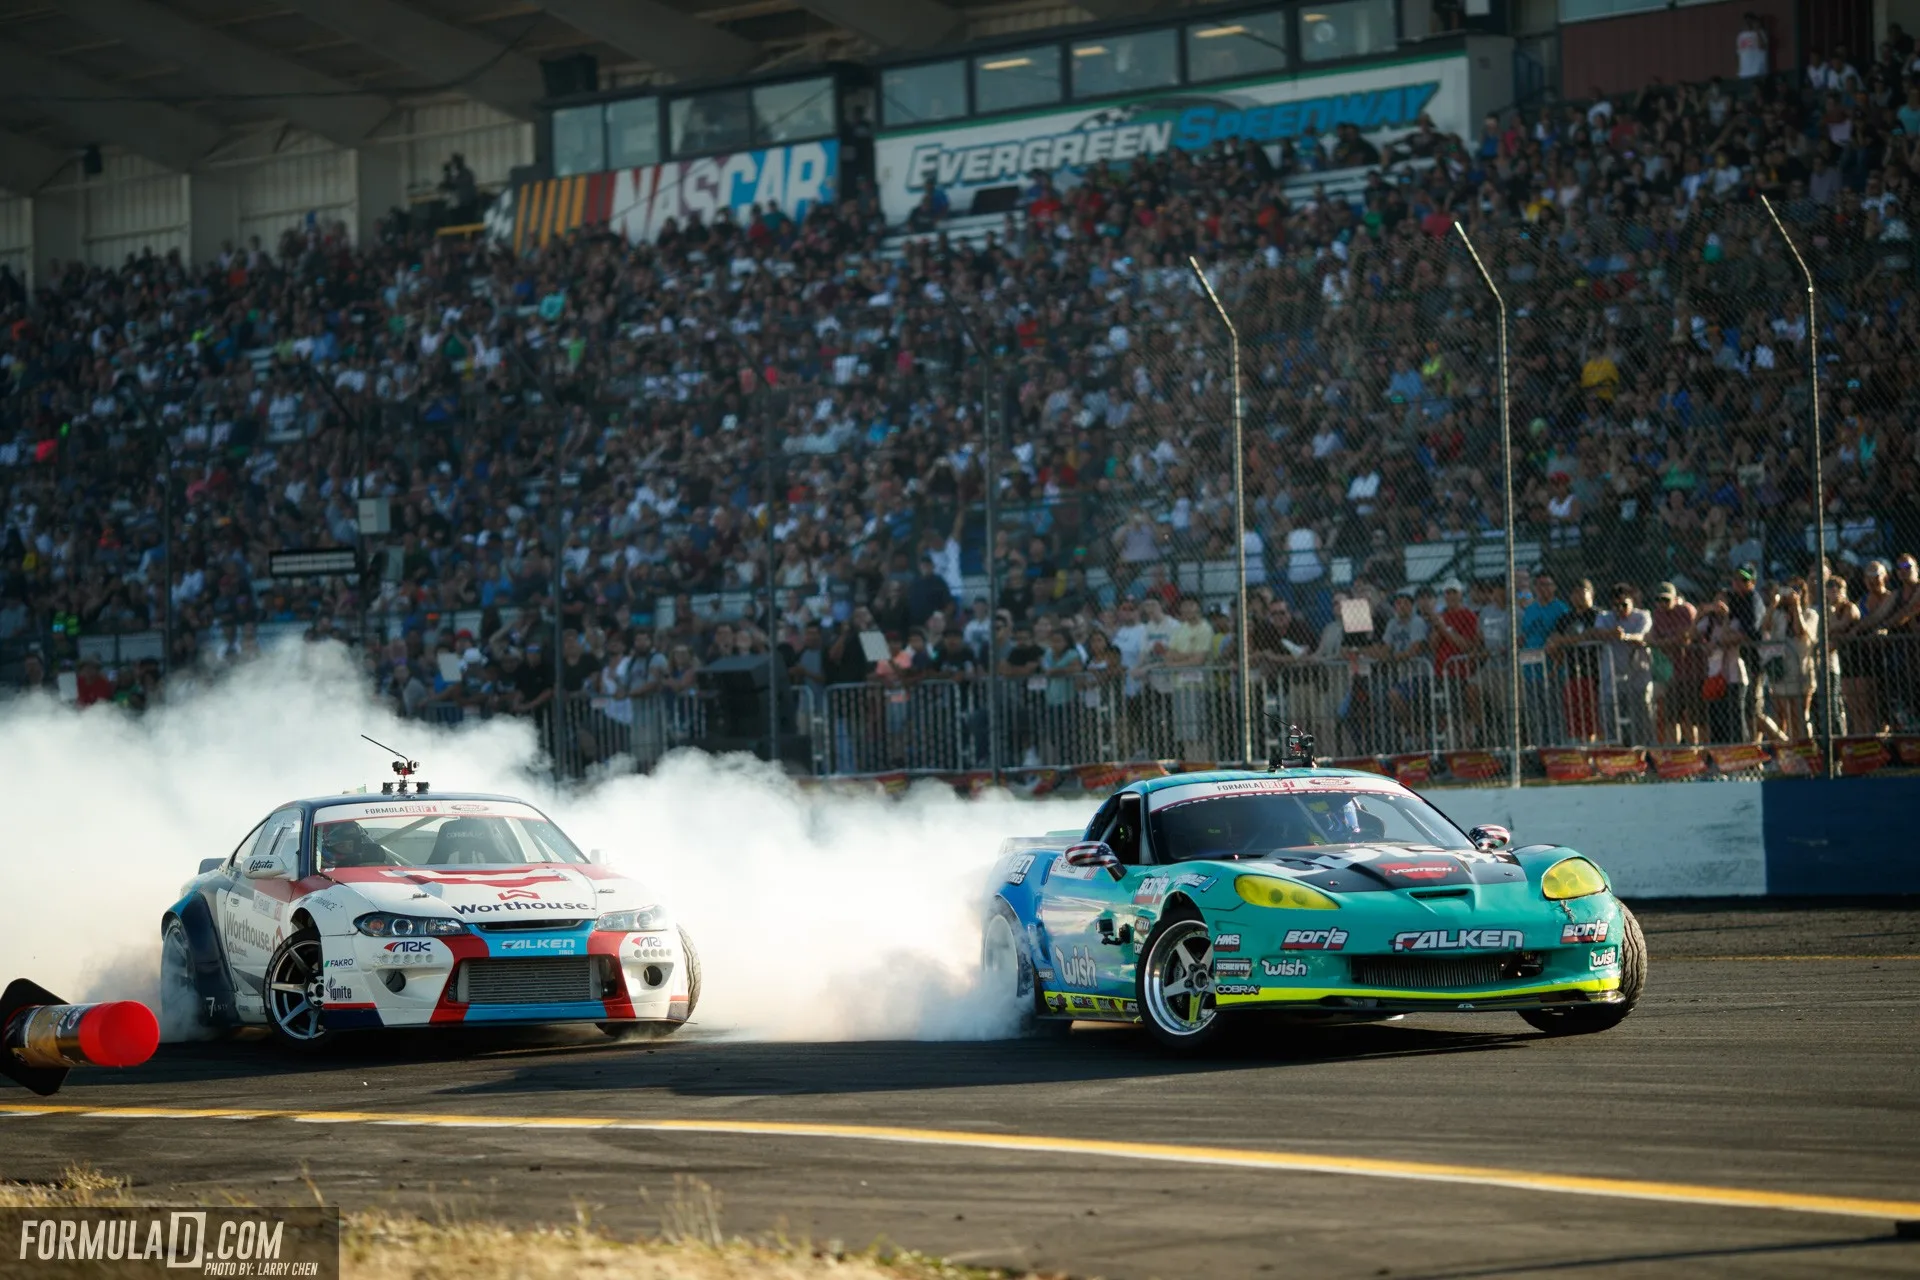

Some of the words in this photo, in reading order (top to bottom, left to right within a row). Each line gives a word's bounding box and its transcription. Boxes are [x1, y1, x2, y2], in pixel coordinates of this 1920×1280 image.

[905, 120, 1173, 192] EVERGREEN
[1174, 80, 1441, 152] SPEEDWAY
[609, 141, 828, 246] NASCAR
[1217, 782, 1260, 791] FORMULA
[365, 806, 405, 814] FORMULA
[1390, 866, 1453, 874] VORTECH
[452, 901, 596, 915] Worthouse.
[501, 938, 575, 950] FALKEN
[1214, 934, 1240, 946] HMS
[1392, 929, 1523, 949] FALKEN
[386, 941, 431, 953] ARK
[330, 958, 354, 967] FAKRO
[1216, 985, 1258, 993] COBRA
